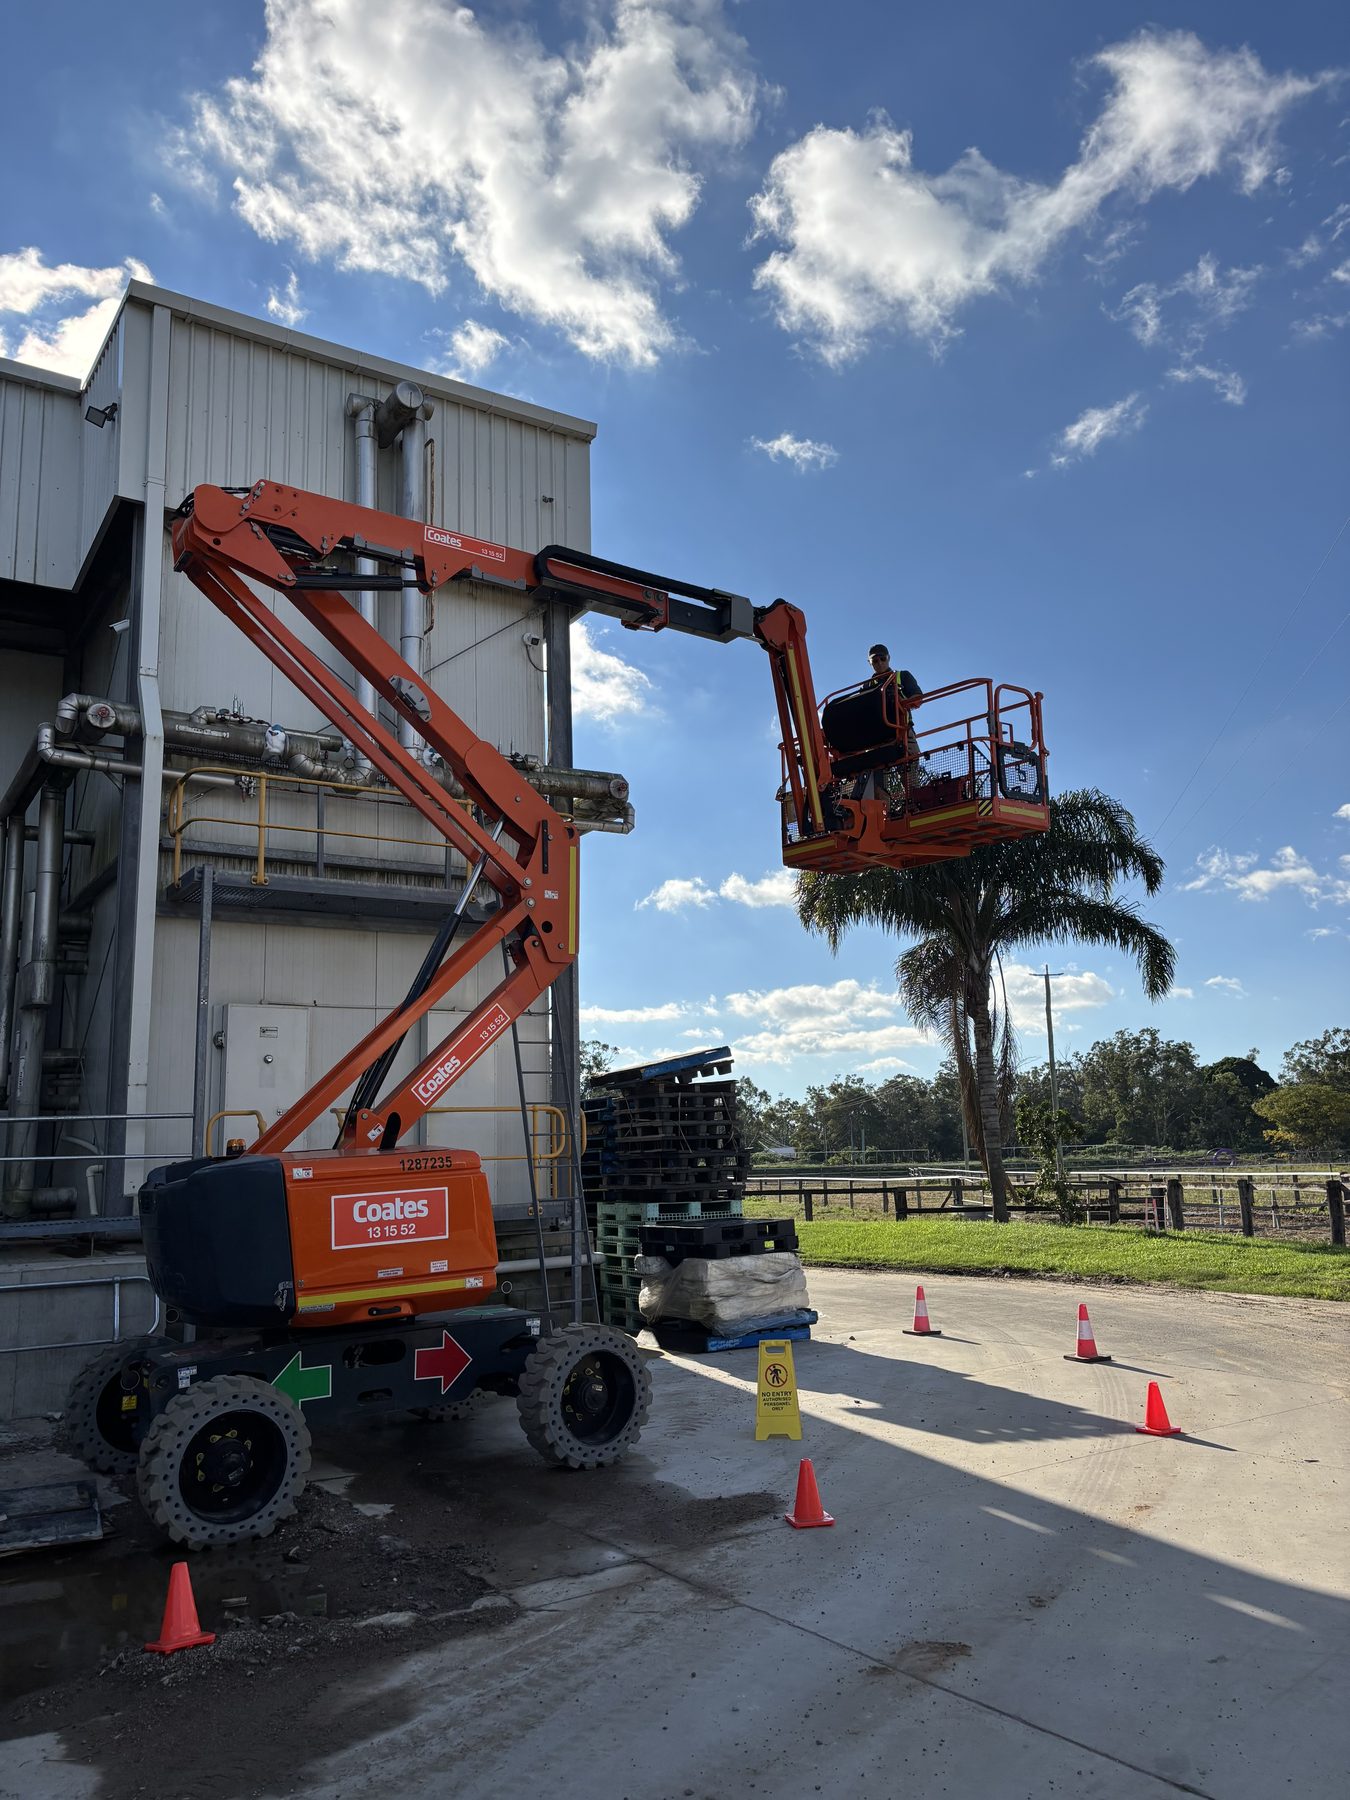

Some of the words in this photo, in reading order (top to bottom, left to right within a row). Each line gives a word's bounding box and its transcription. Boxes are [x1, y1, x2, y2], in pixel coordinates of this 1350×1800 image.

[427, 530, 462, 547] Coates
[480, 1030, 489, 1040] 13
[487, 1023, 497, 1033] 15
[495, 1014, 505, 1025] 52
[418, 1055, 461, 1099] Coates
[400, 1156, 453, 1171] 1287235
[353, 1198, 429, 1223] Coates
[367, 1226, 381, 1238] 13
[384, 1225, 398, 1237] 15
[400, 1223, 416, 1236] 52
